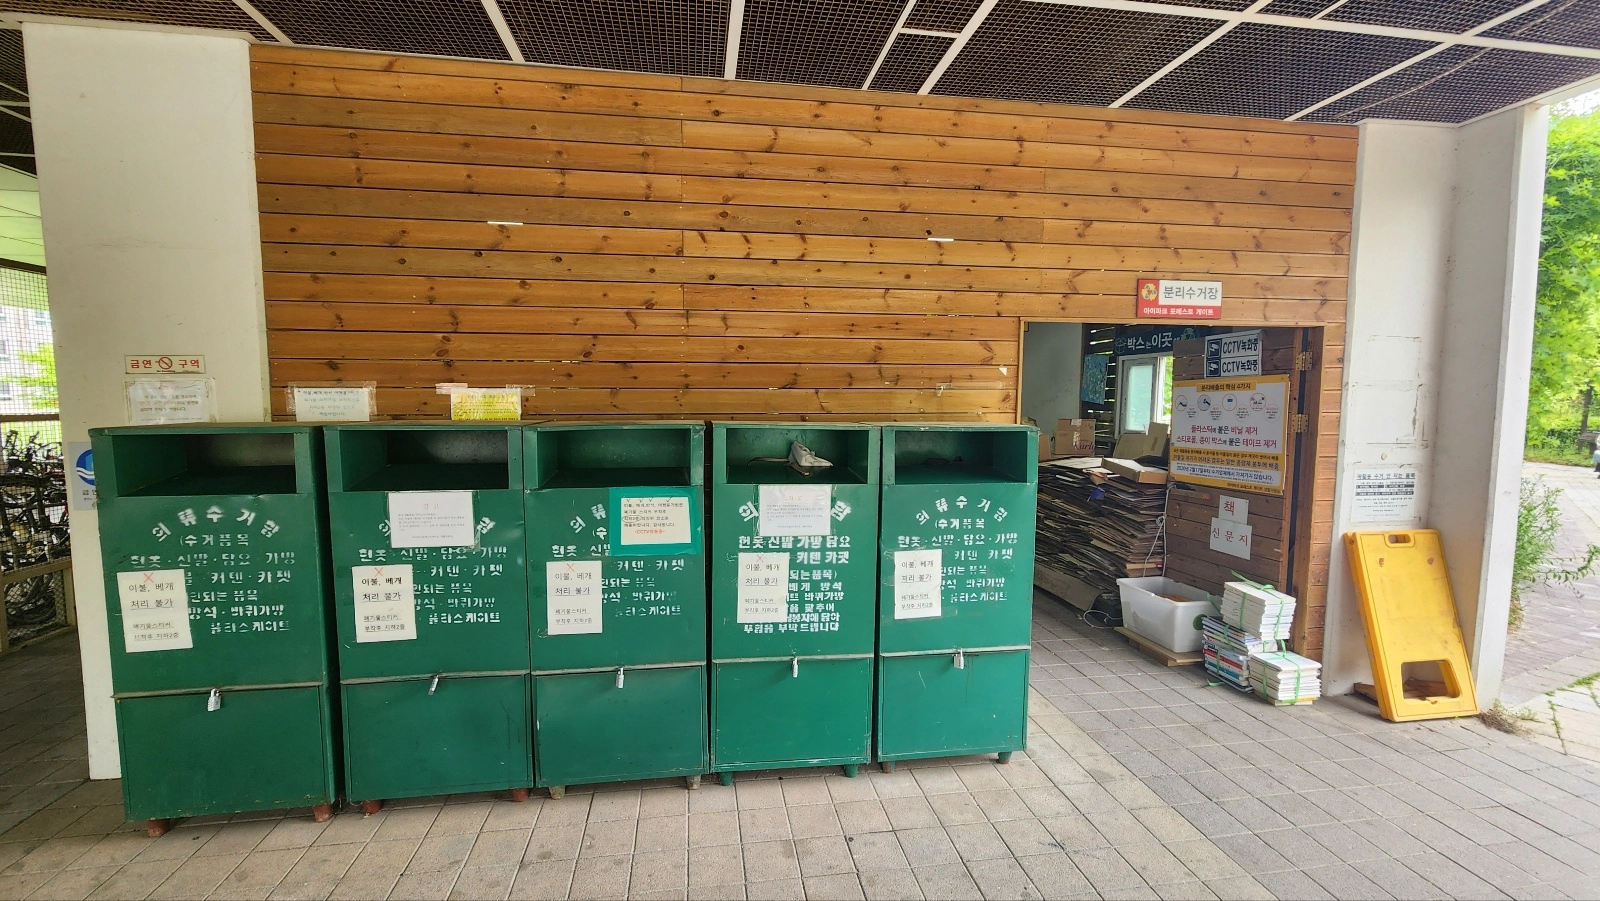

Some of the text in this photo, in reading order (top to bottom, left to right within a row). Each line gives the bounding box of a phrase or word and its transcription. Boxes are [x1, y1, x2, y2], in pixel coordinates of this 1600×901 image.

[1164, 286, 1218, 300] 분리수거장
[1223, 338, 1258, 353] CCTV녹화중
[131, 360, 199, 368] 금연 구역
[1222, 359, 1257, 373] CCTV녹화중
[1191, 425, 1257, 435] 플라스틱에 붙은 비닐 제거
[1212, 437, 1227, 445] 박스에
[1229, 438, 1240, 446] 붙은
[1243, 439, 1261, 447] 테이프
[1264, 440, 1276, 448] 제거
[916, 496, 1008, 525] 의류수거함
[1224, 501, 1234, 516] 책
[739, 536, 850, 548] 헌옷 신발 가방 담요
[898, 533, 1018, 547] 헌옷 신발 담요 가방
[1212, 528, 1247, 546] 신문지
[359, 549, 386, 561] 헌옷
[401, 548, 428, 560] 신발
[481, 546, 507, 558] 가방
[552, 545, 577, 557] 헌옷
[131, 552, 295, 568] 헌옷 신발 담요 가방
[821, 582, 842, 591] 방석
[966, 577, 1005, 588] 바퀴가방
[363, 592, 401, 601] 처리 불가
[805, 592, 844, 601] 바퀴가방
[131, 599, 173, 608] 처리 불가
[805, 603, 834, 613] 맞추어
[821, 612, 840, 621] 담아
[779, 622, 839, 633] 부탁드립니다
